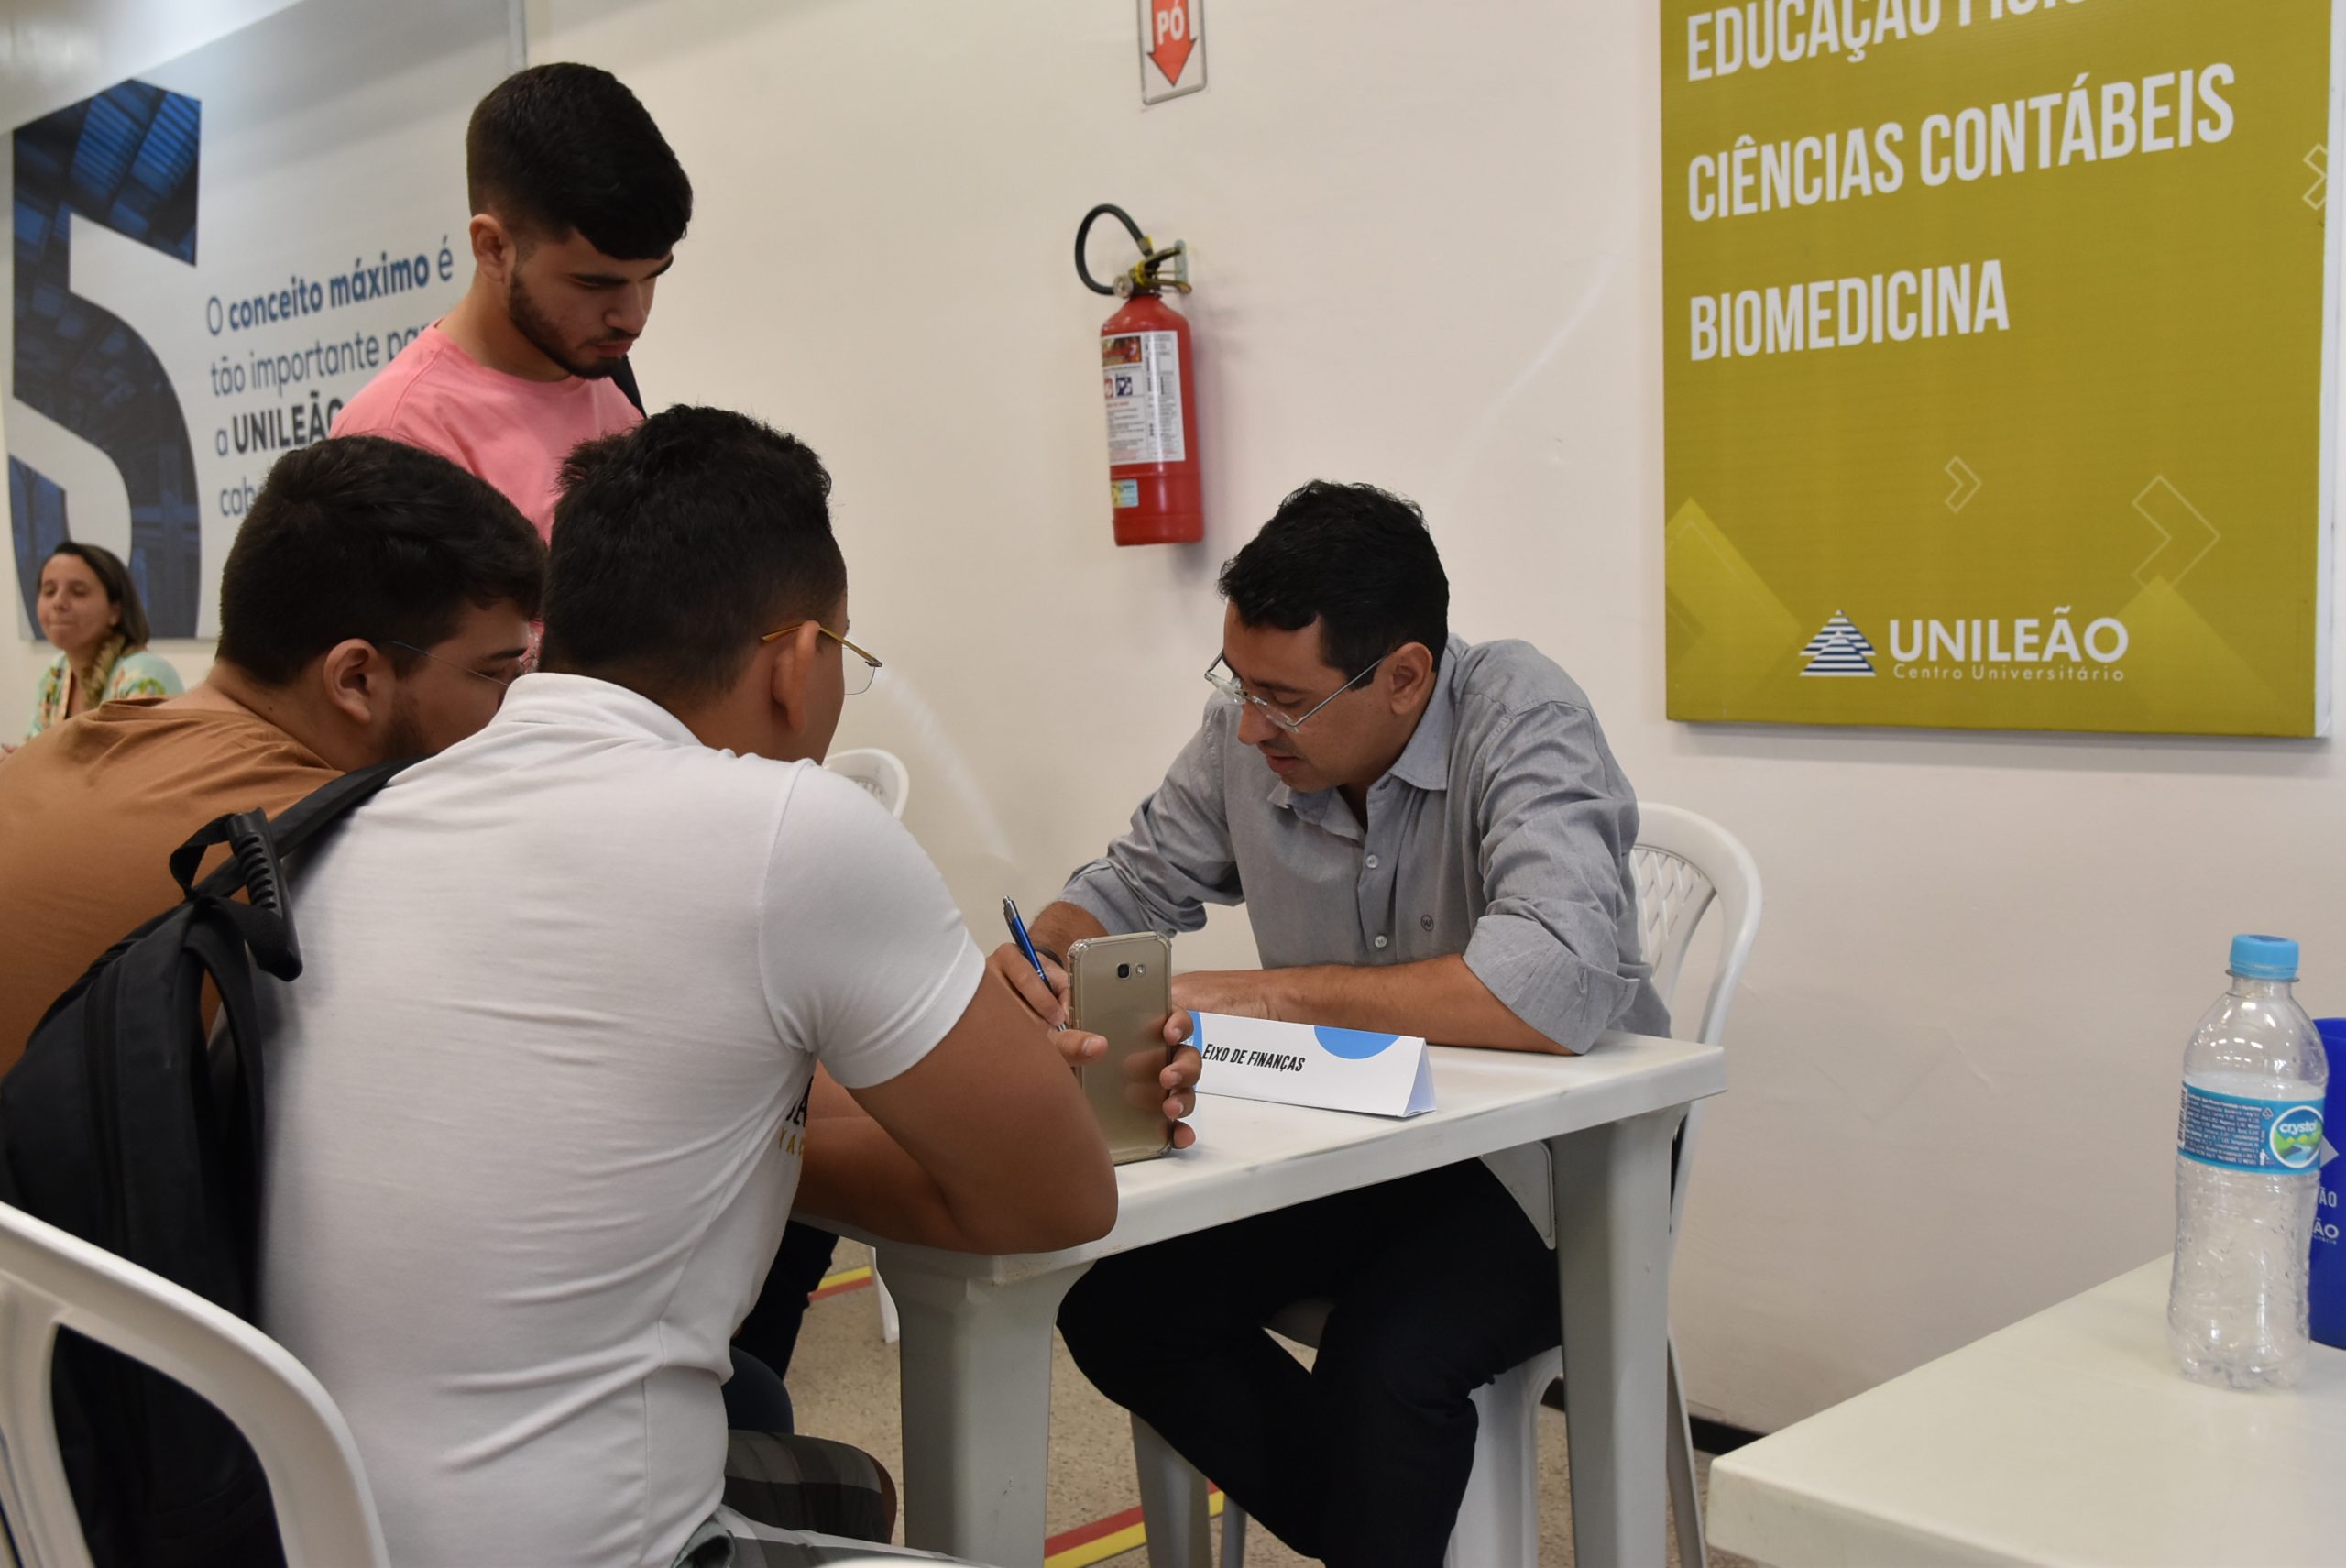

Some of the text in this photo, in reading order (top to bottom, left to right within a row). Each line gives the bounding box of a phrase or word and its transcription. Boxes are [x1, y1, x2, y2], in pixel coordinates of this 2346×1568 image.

[1157, 0, 1185, 45] PÓ
[1687, 62, 2236, 222] CIÊNCIAS CONTÁBEIS
[207, 235, 454, 336] O conceito máximo é
[1690, 258, 2011, 362] BIOMEDICINA
[211, 356, 246, 396] tão
[249, 332, 379, 398] importante
[216, 428, 228, 456] a
[220, 476, 265, 517] cab
[1889, 604, 2129, 663] UNILEÃO
[1893, 663, 2124, 682] Centro Universitário
[1201, 1044, 1306, 1072] EIXO DE FINANÇAS
